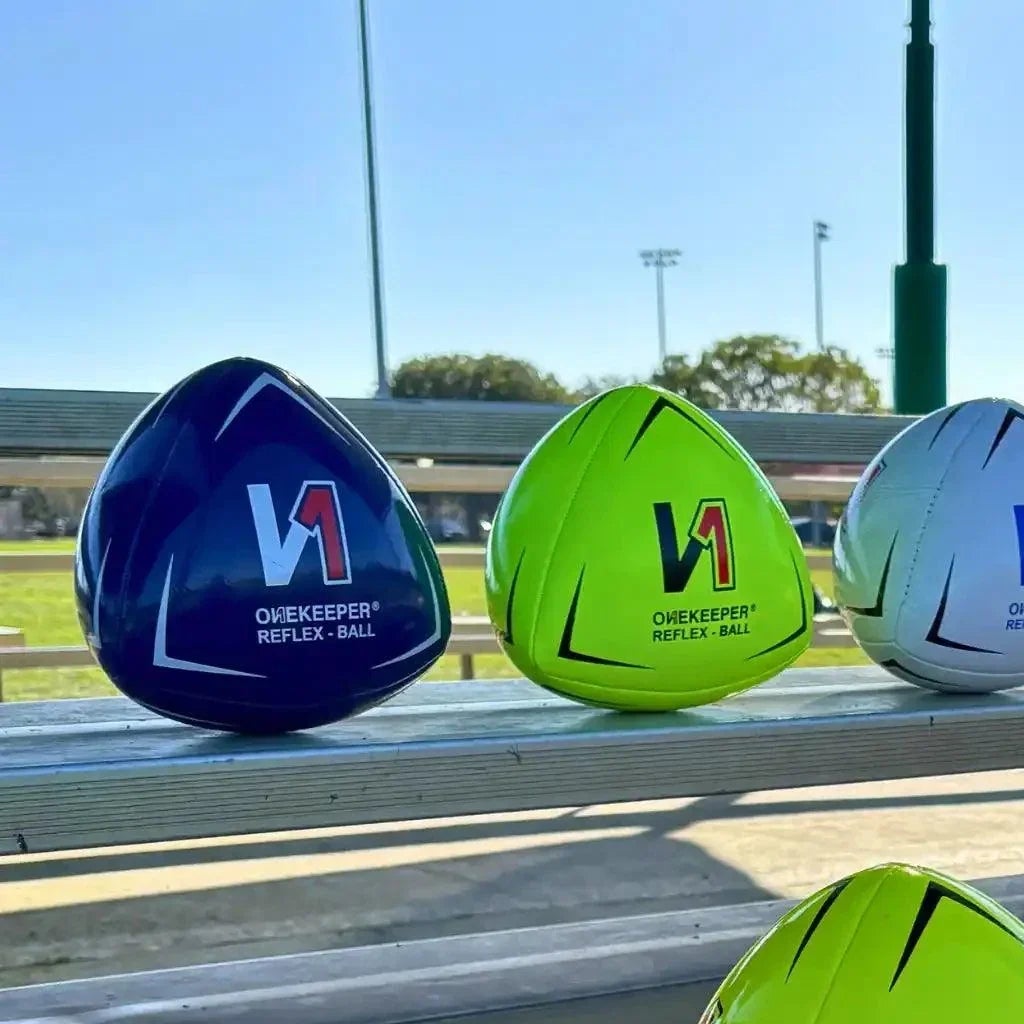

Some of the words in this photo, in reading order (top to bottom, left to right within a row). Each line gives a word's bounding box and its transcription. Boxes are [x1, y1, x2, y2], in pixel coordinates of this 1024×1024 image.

[257, 626, 324, 644] REFLEX
[337, 623, 376, 639] BALL
[653, 626, 708, 642] REFLEX
[719, 623, 751, 637] BALL
